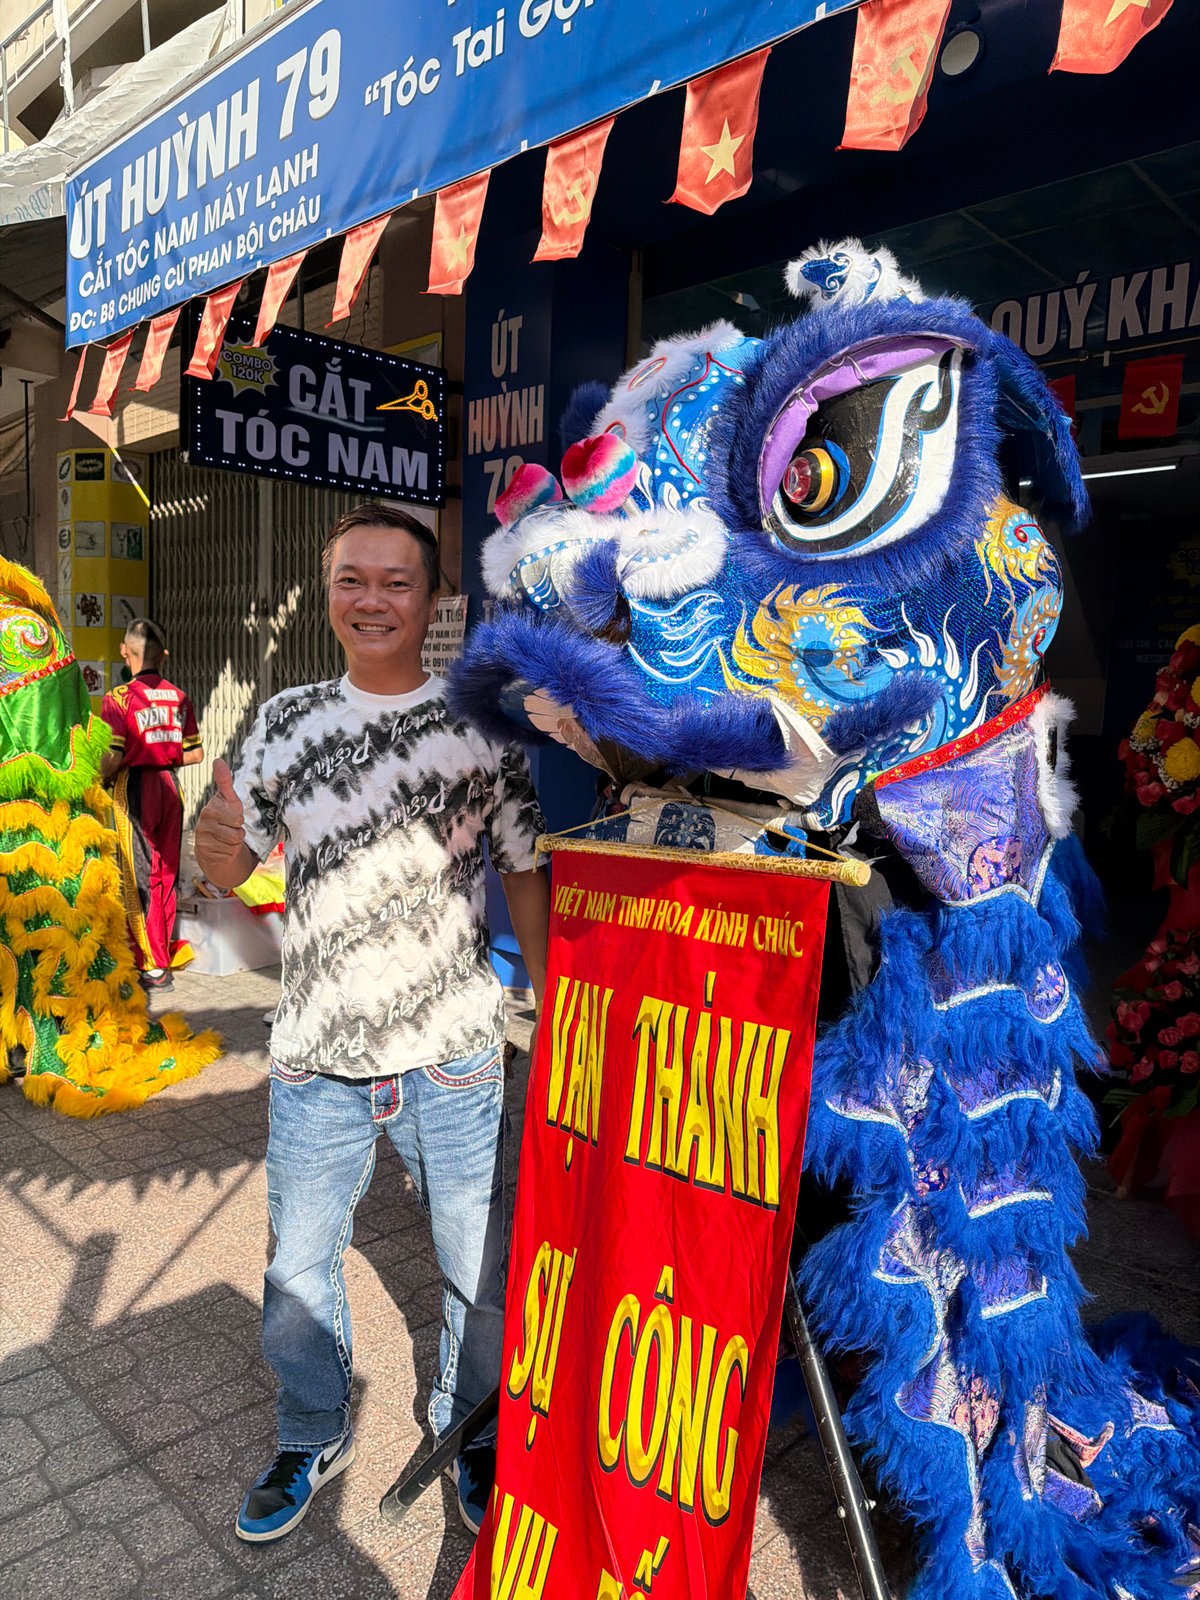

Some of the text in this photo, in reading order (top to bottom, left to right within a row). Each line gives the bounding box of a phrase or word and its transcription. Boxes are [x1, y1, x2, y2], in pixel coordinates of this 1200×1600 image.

[452, 8, 505, 76] Tai
[519, 0, 596, 37] Gọ
[70, 29, 342, 260] ÚT HUỲNH 79
[79, 143, 319, 298] CẮT TÓC NAM MÁY LẠNH
[70, 195, 321, 332] ĐC: B8 CHUNG CƯ PHAN BỘI CHÂU
[491, 309, 523, 378] ÚT
[991, 270, 1098, 356] QUÝ
[222, 350, 273, 371] COMBO
[231, 364, 265, 383] 120K
[289, 357, 372, 423] CẮT
[215, 408, 429, 490] TÓC NAM
[467, 381, 545, 456] HUỲNH
[303, 730, 369, 780] Positive
[379, 780, 446, 835] Positive
[553, 881, 804, 958] VIỆT NAM TINH HOA KÍNH CHÚC
[546, 975, 615, 1173] VẠN
[506, 1240, 577, 1452] SỰ
[597, 1264, 749, 1527] CÔNG
